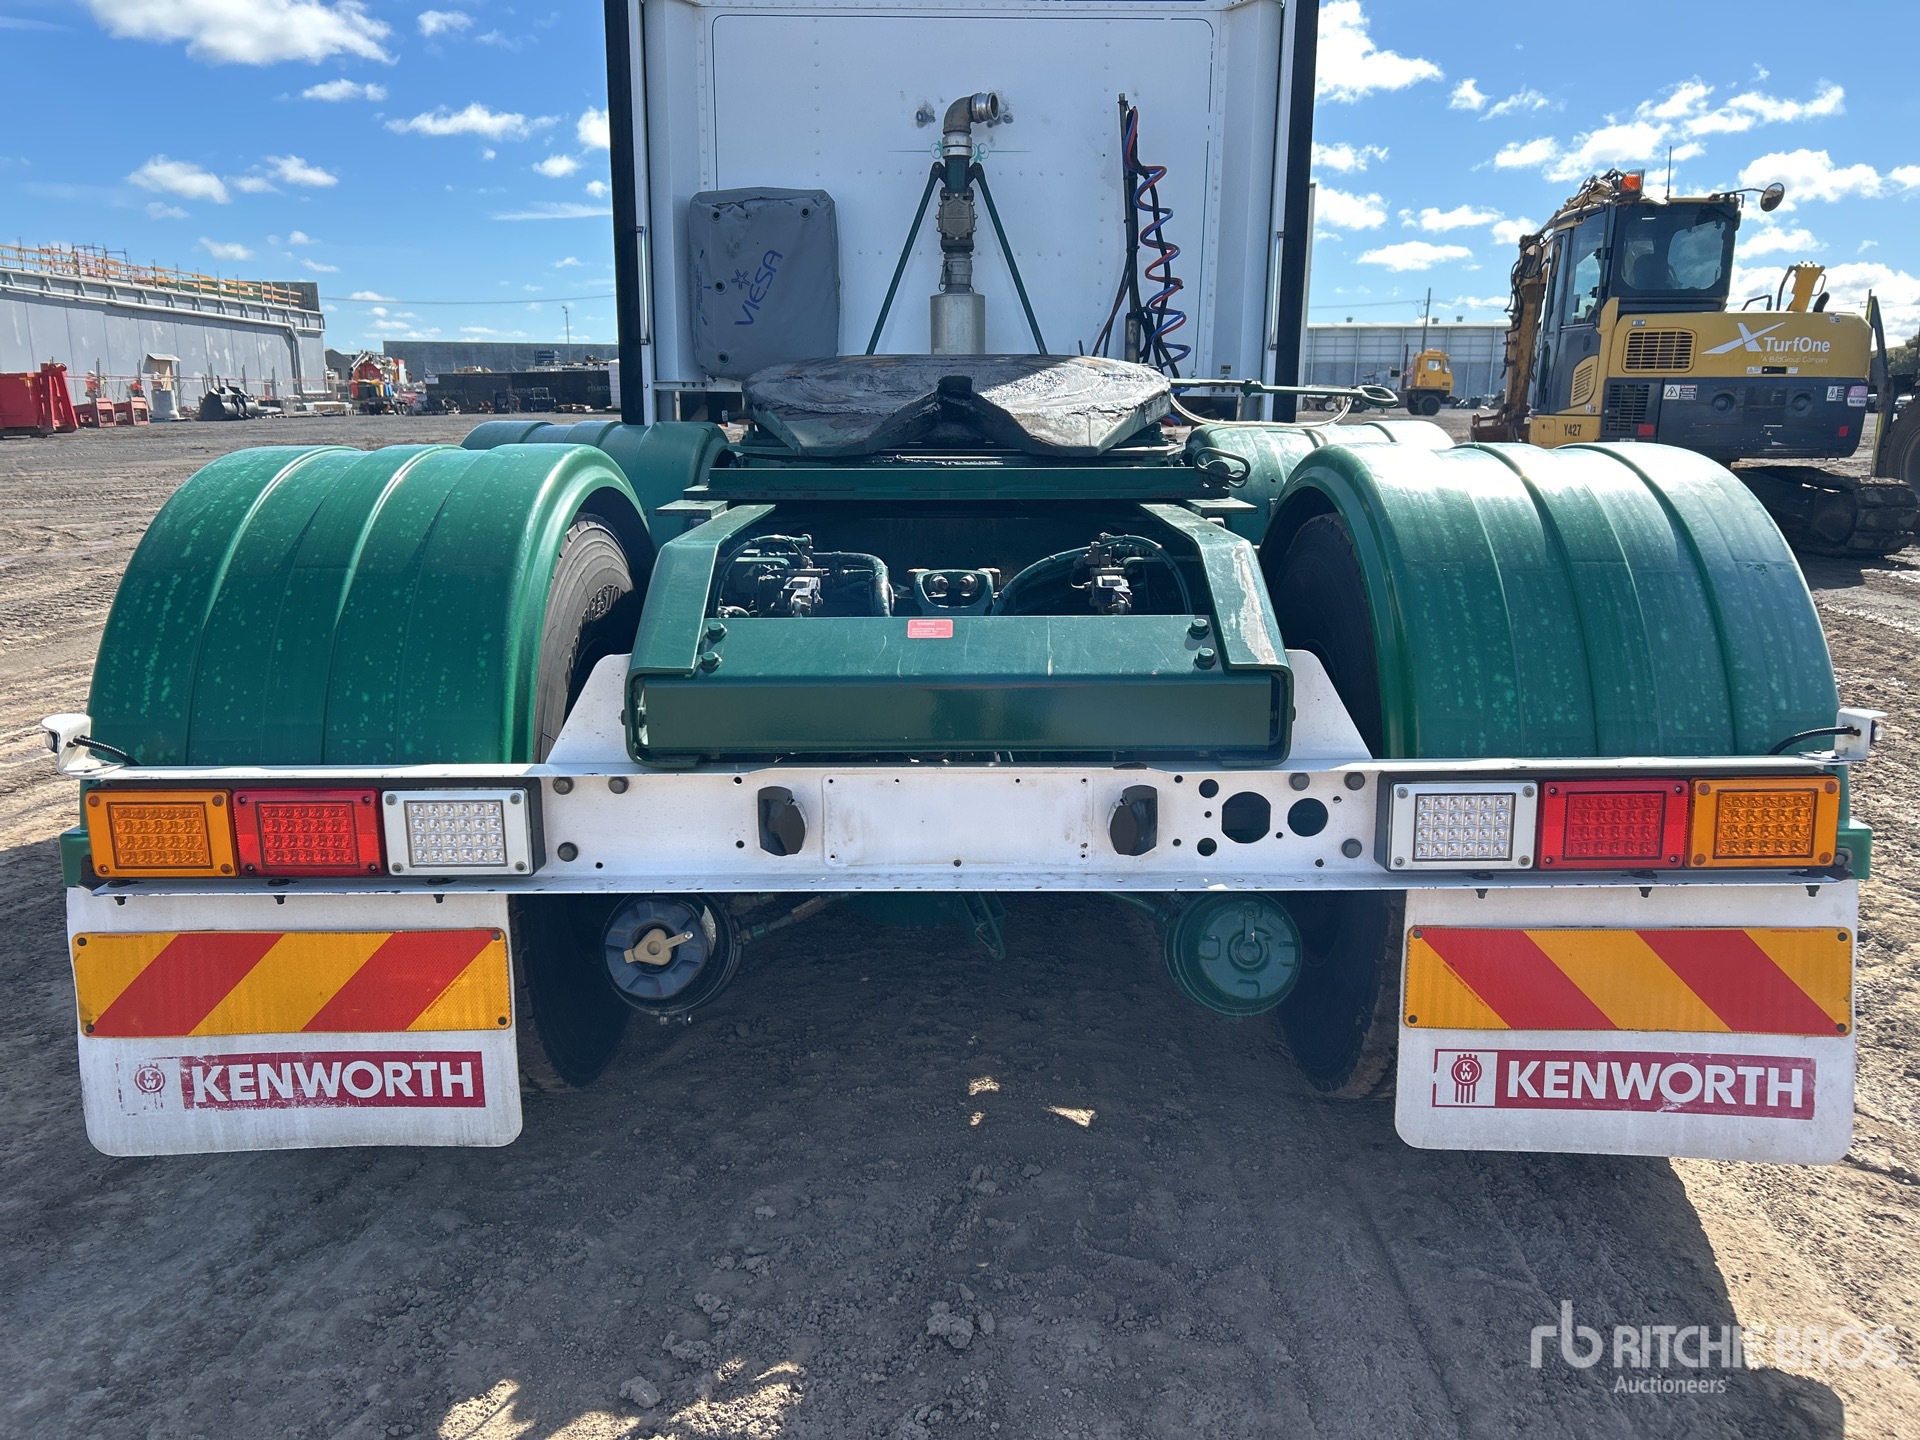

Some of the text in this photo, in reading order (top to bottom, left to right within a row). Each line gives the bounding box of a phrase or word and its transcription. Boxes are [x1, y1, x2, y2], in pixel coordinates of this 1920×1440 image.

[1763, 336, 1831, 353] TurfOne
[1564, 424, 1581, 437] Y427
[193, 1060, 474, 1103] KENWORTH
[1507, 1059, 1804, 1109] KENWORTH
